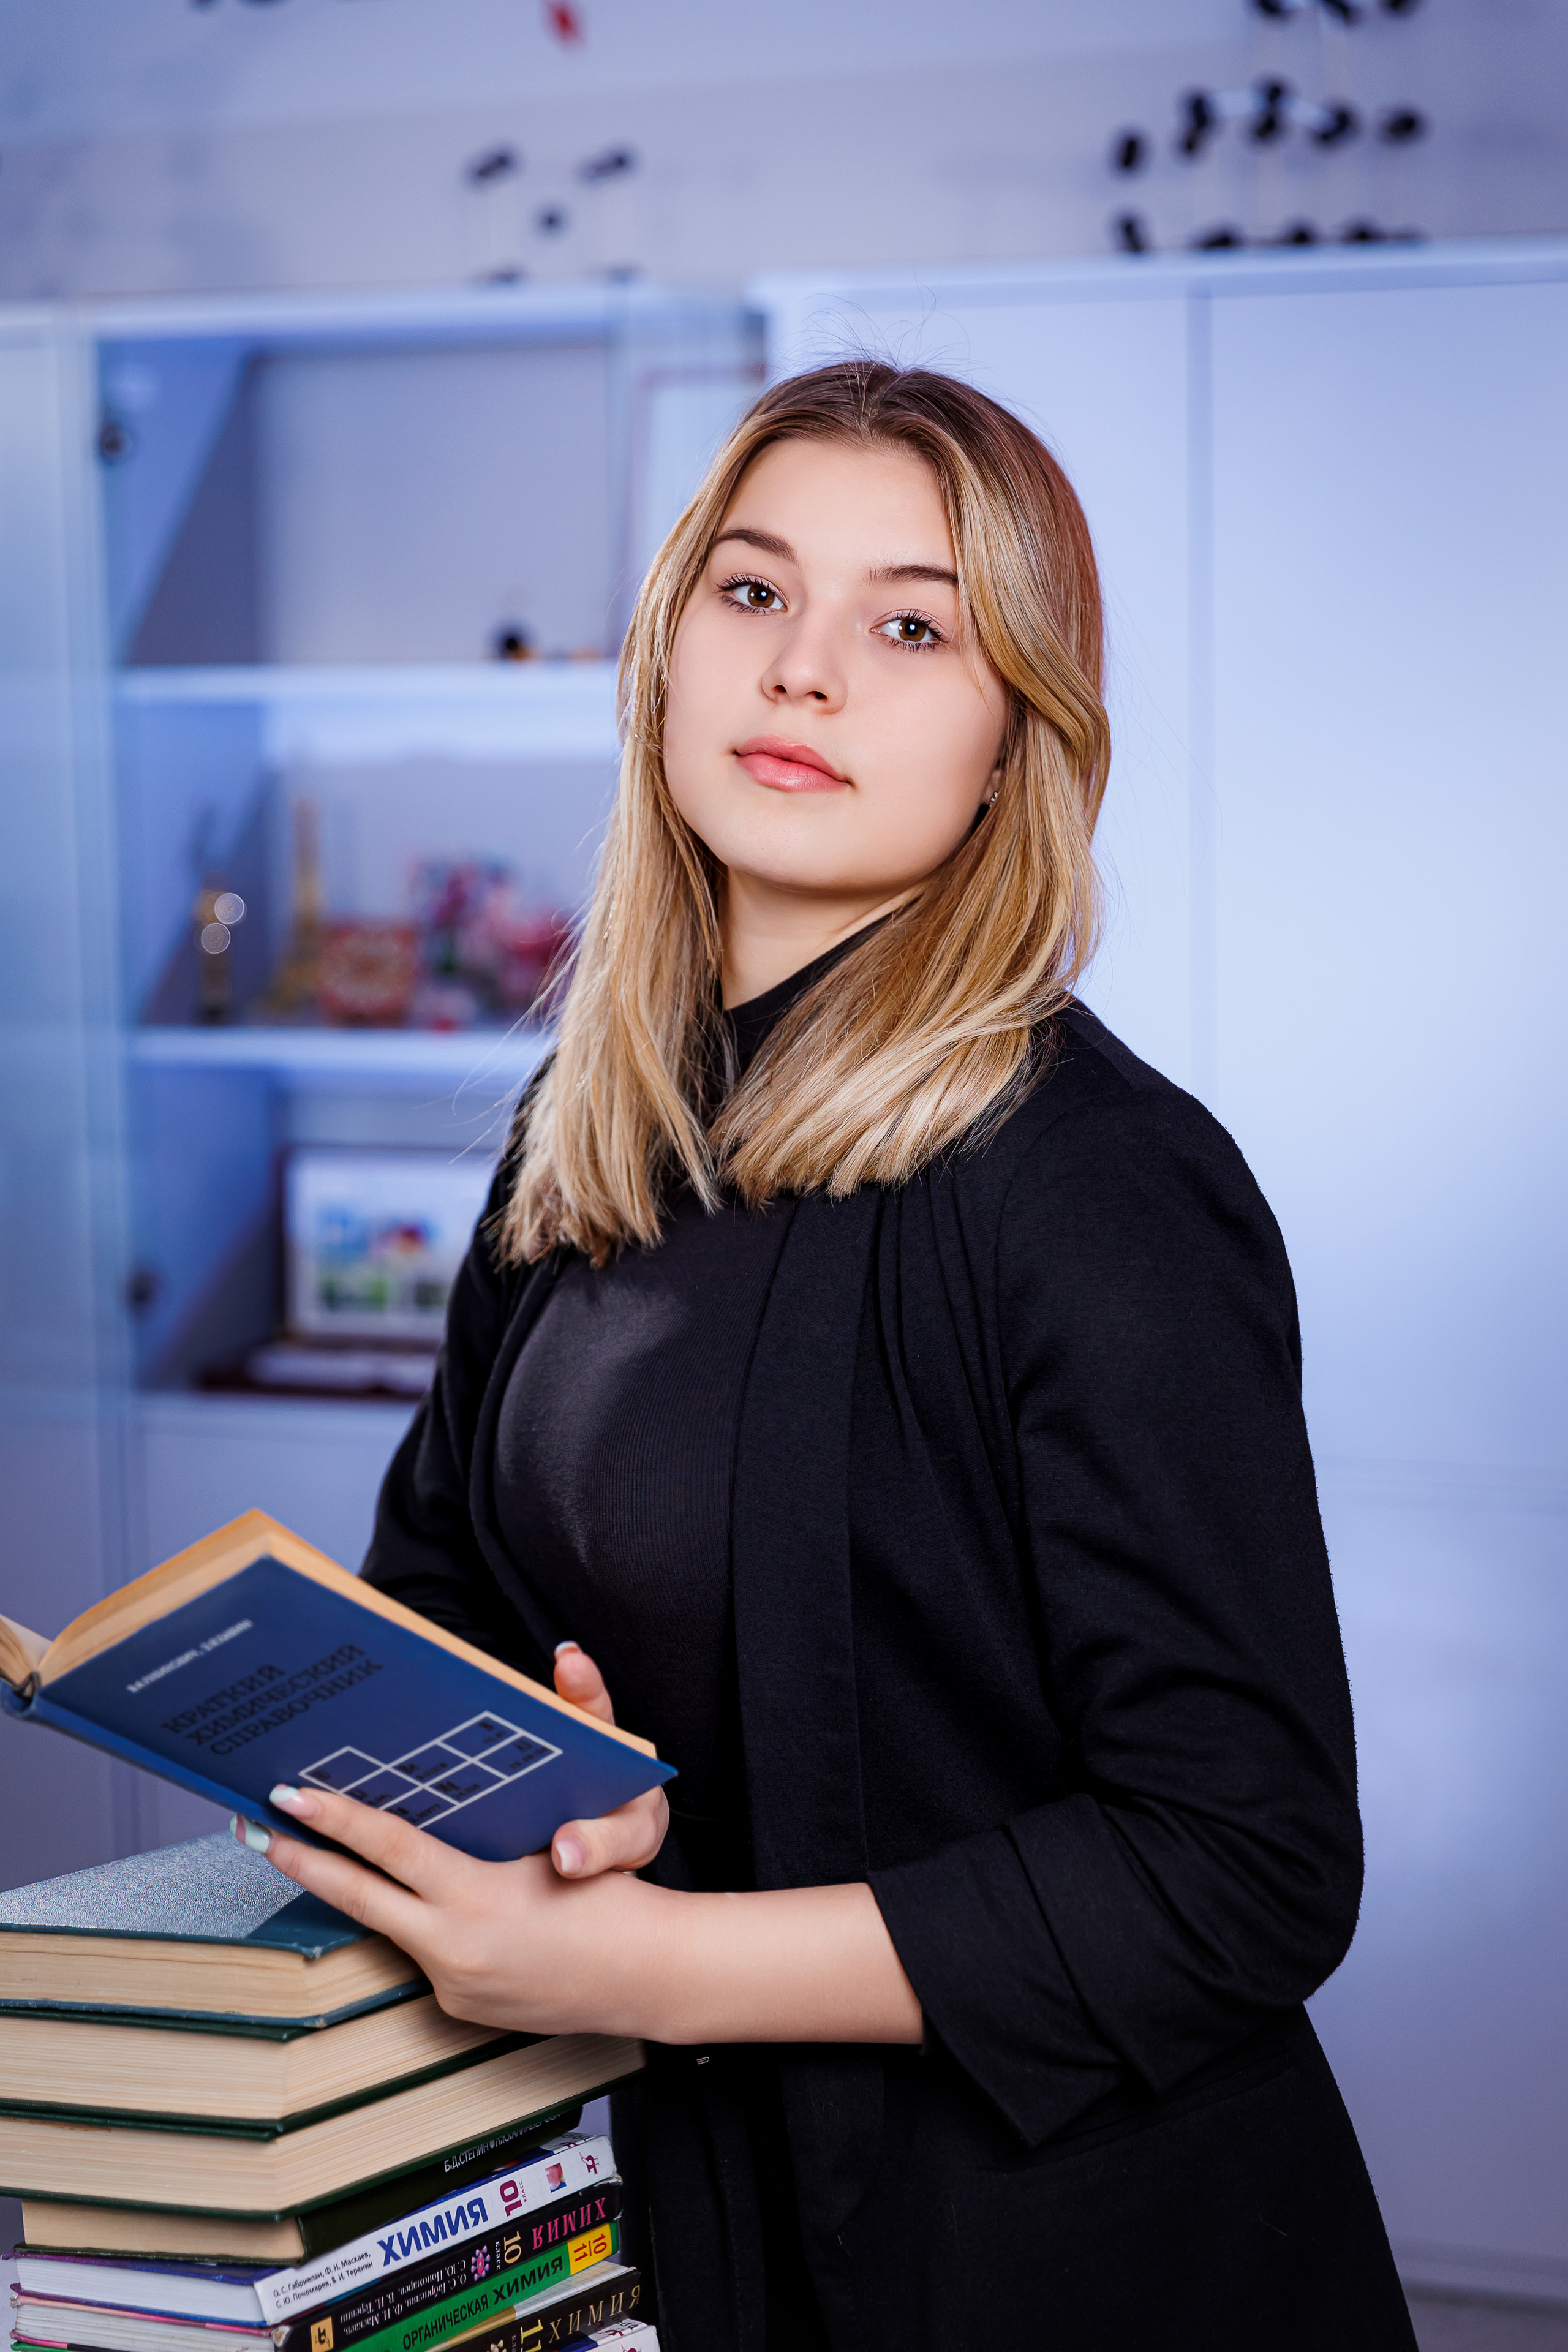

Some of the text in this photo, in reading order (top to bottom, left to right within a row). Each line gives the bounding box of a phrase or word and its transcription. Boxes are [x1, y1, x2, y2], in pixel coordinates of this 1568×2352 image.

[161, 1664, 285, 1734] КРАТКИЙ
[187, 1644, 366, 1745] ХИМИЧЕСКИЙ
[211, 1659, 383, 1755] СПРАВОЧНИК
[499, 2180, 522, 2217] 10
[377, 2197, 489, 2267] ХИМИЯ
[532, 2197, 606, 2250] ХИМИЯ
[593, 2233, 607, 2254] 10
[503, 2231, 522, 2264] 10
[574, 2243, 588, 2262] 11
[288, 2272, 325, 2292] Габриелян,
[325, 2267, 334, 2275] Ф.
[334, 2263, 341, 2271] Н.
[341, 2252, 371, 2268] Маскаев,
[293, 2282, 331, 2301] Пономарев,
[338, 2272, 345, 2281] И.
[345, 2261, 374, 2278] Теренин
[398, 2269, 443, 2296] Пономарев,
[341, 2302, 374, 2324] Теренин
[402, 2256, 564, 2350] ОРГАНИЧЕСКАЯ ХИМИЯ
[405, 2283, 446, 2307] Габриелян,
[549, 2285, 641, 2343] ХИМИЯ
[344, 2316, 379, 2336] Маскаев,
